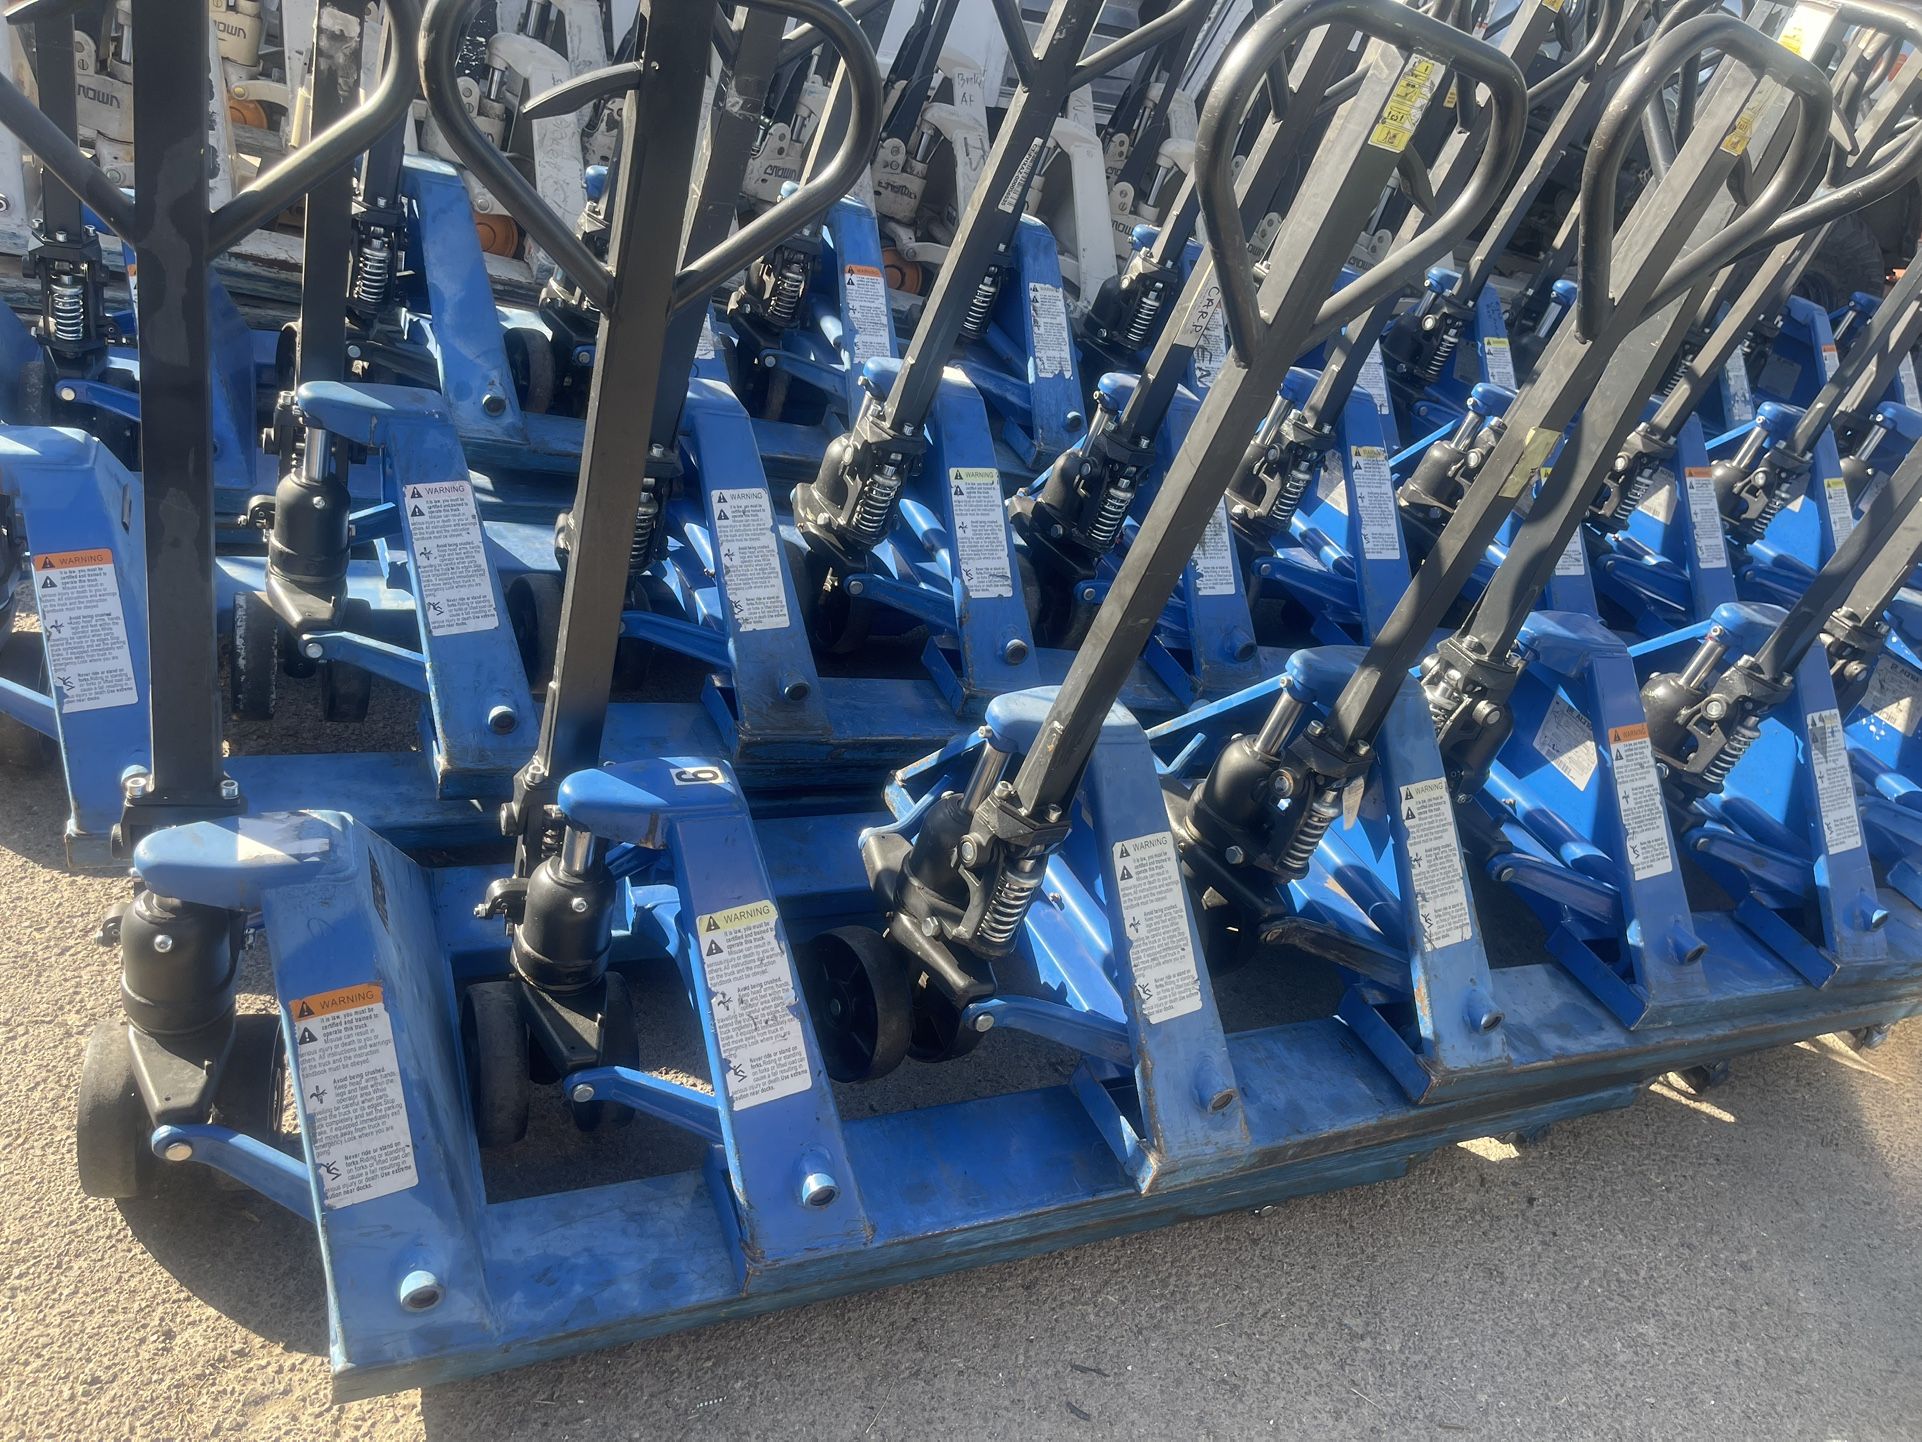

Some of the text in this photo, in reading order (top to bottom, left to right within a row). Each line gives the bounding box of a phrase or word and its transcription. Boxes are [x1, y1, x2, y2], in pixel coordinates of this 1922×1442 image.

[965, 471, 994, 479] WARNING
[425, 485, 464, 495] WARNING
[730, 492, 762, 500] WARNING
[60, 555, 103, 564] WARNING
[1415, 782, 1443, 794] WARNING
[1132, 837, 1168, 852] WARNING
[724, 904, 770, 924] WARNING
[319, 990, 374, 1010] WARNING
